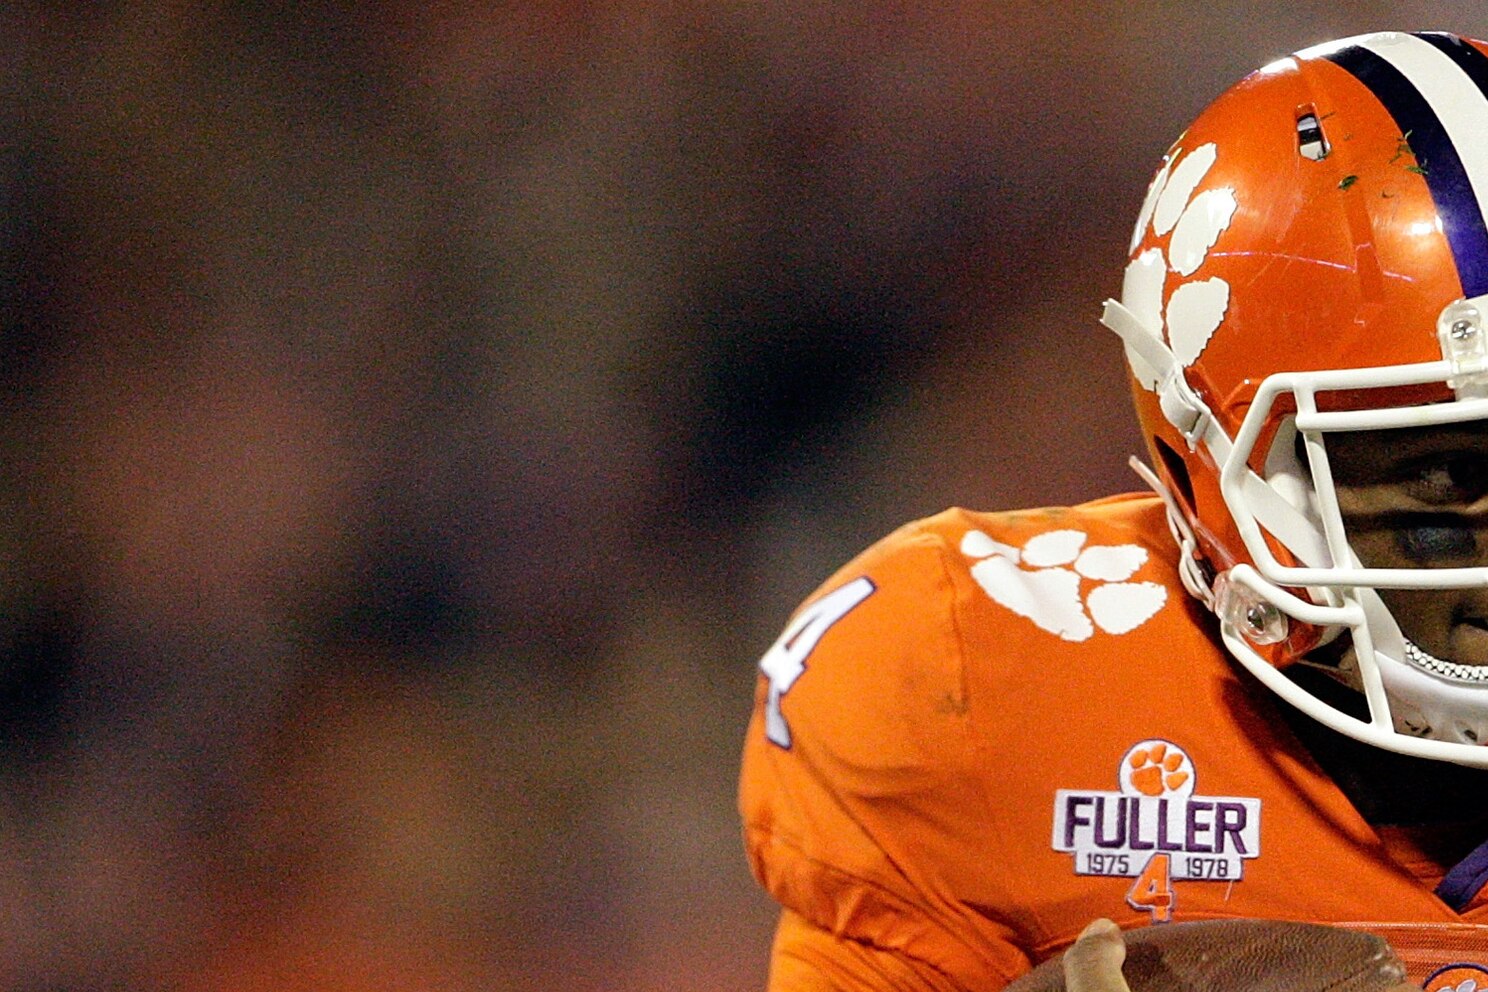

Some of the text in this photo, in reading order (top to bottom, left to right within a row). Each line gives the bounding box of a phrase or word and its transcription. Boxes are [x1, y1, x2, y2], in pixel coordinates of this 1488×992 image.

[759, 575, 878, 750] 4
[1064, 796, 1247, 854] FULLER
[1086, 853, 1228, 878] 1975 1978
[1126, 851, 1176, 923] 4
